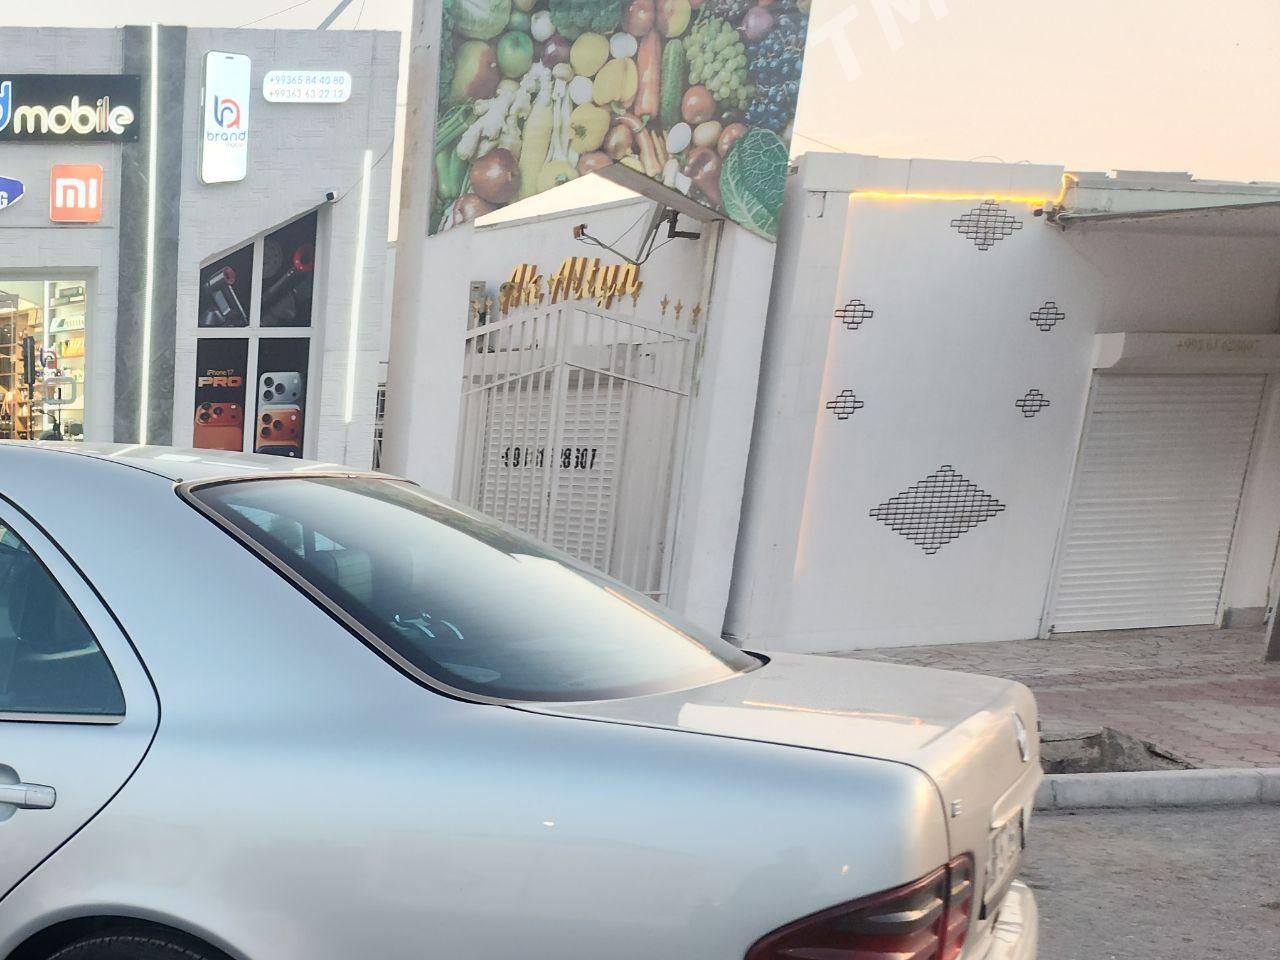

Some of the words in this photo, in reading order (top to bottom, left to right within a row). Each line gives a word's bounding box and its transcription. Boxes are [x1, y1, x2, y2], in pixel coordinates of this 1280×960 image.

[13, 95, 135, 134] mobile
[206, 131, 246, 141] brand
[551, 256, 643, 309] Altyn
[198, 376, 242, 387] PRO
